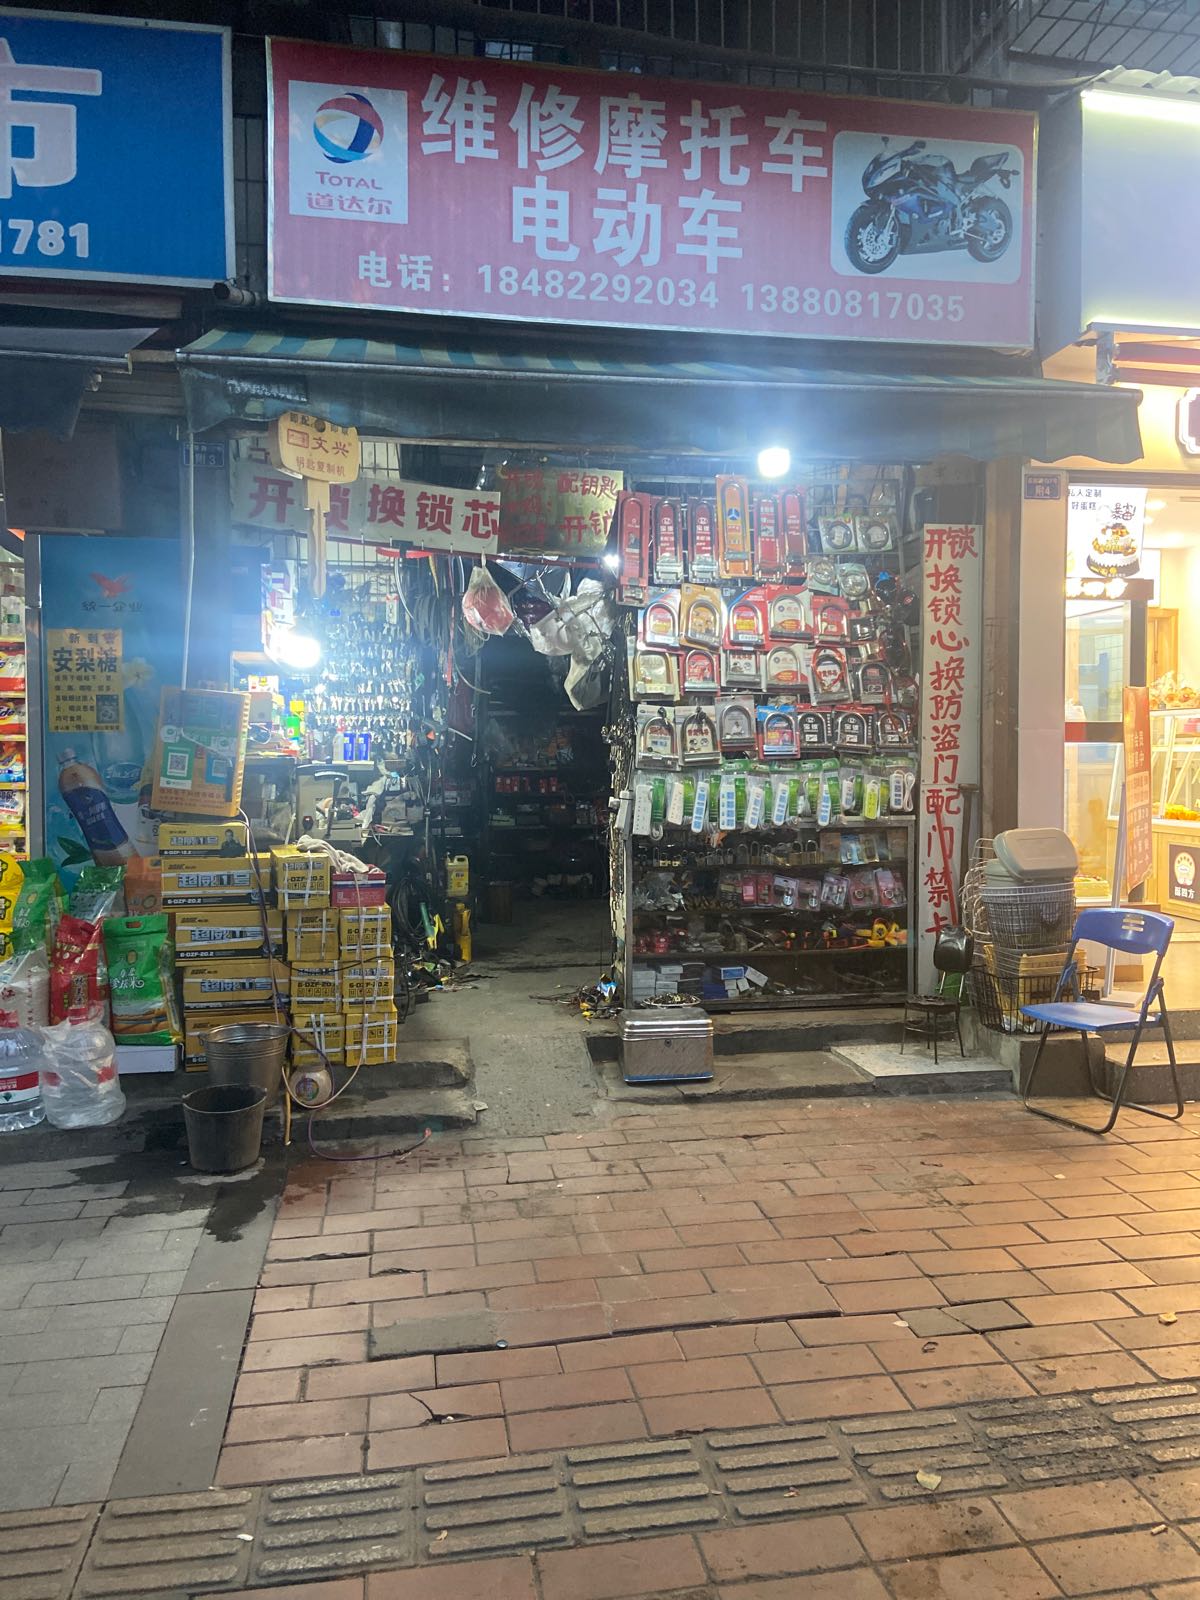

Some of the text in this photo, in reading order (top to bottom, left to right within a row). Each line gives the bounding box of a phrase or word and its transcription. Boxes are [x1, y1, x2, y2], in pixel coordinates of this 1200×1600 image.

[420, 73, 829, 193] 维修摩托车
[315, 171, 383, 190] TOTAL
[306, 193, 393, 215] 道达尔
[0, 218, 89, 258] 781
[512, 175, 743, 274] 电动车
[478, 264, 719, 309] 18482292034
[741, 283, 965, 324] 13880817035
[311, 436, 350, 459] 文兴
[557, 471, 617, 499] 配钥匙
